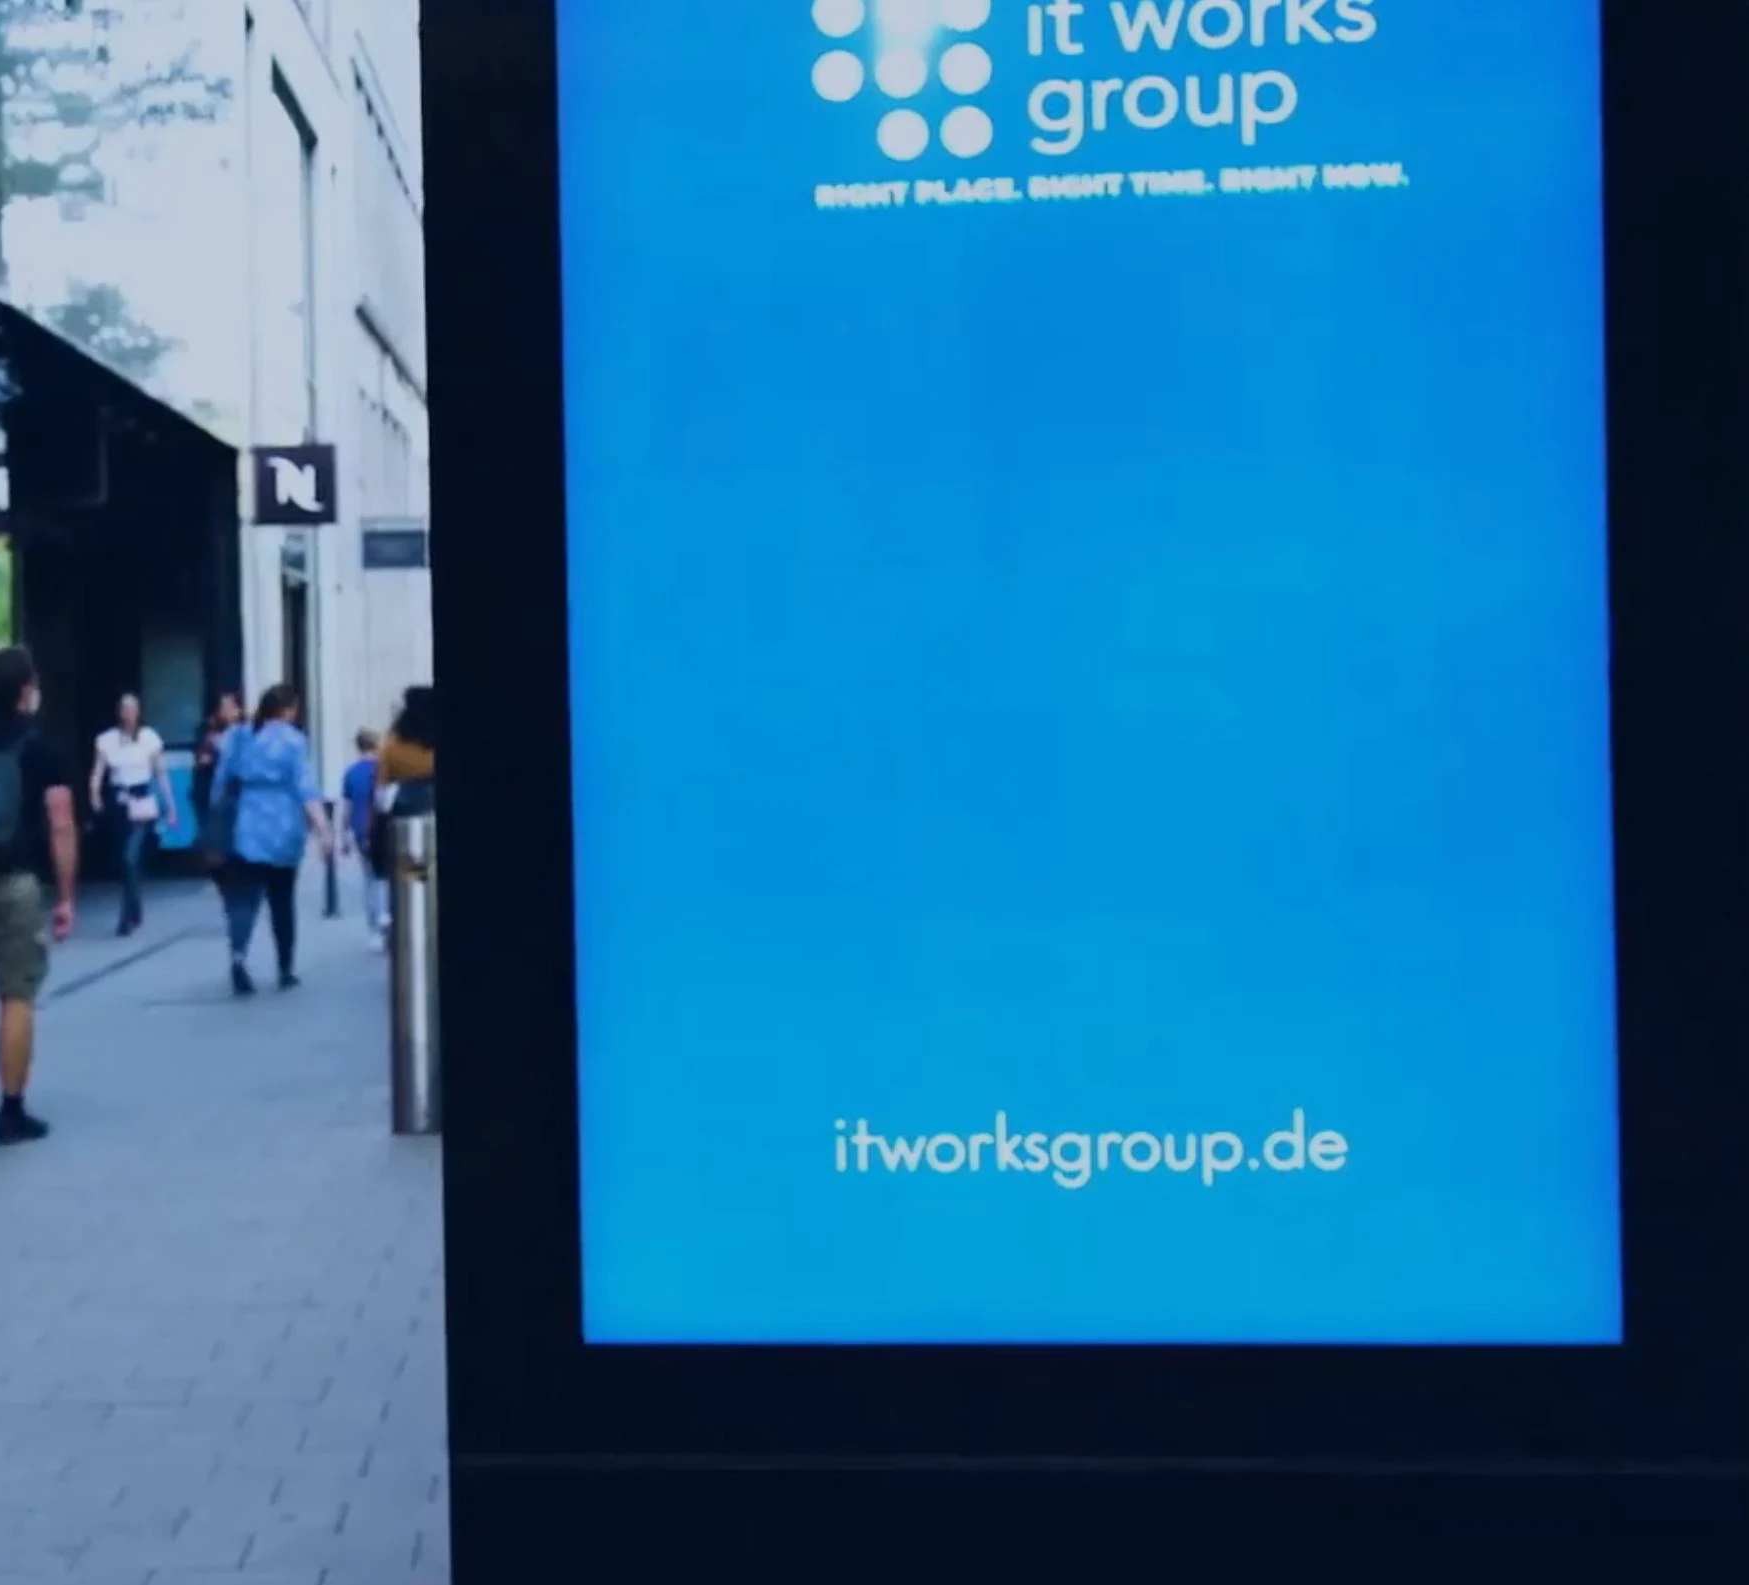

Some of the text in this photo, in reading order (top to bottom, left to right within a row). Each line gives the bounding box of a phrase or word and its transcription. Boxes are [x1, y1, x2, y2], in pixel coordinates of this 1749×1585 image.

[1026, 0, 1377, 57] it works
[1027, 69, 1298, 156] group
[813, 161, 1410, 209] RIGHT PLACE. RIGHT TIME. RIGHT NOW.
[834, 1107, 1349, 1190] itworksgroup.de
